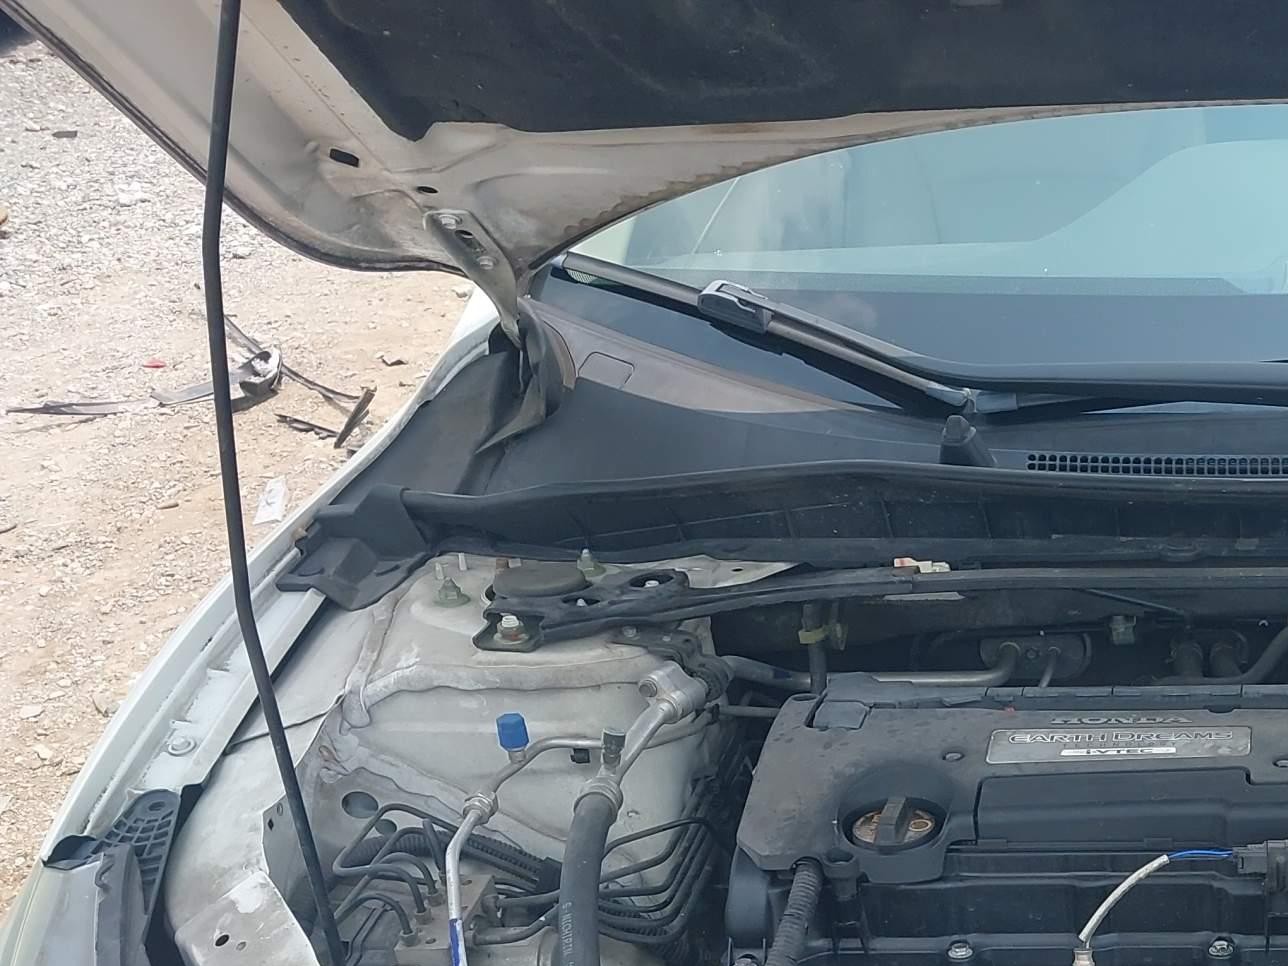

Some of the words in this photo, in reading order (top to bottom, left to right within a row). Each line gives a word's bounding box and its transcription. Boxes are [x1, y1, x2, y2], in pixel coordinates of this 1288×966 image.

[1051, 717, 1192, 725] HONDA
[1009, 733, 1107, 744] EARTH
[1112, 730, 1233, 742] DREAMS
